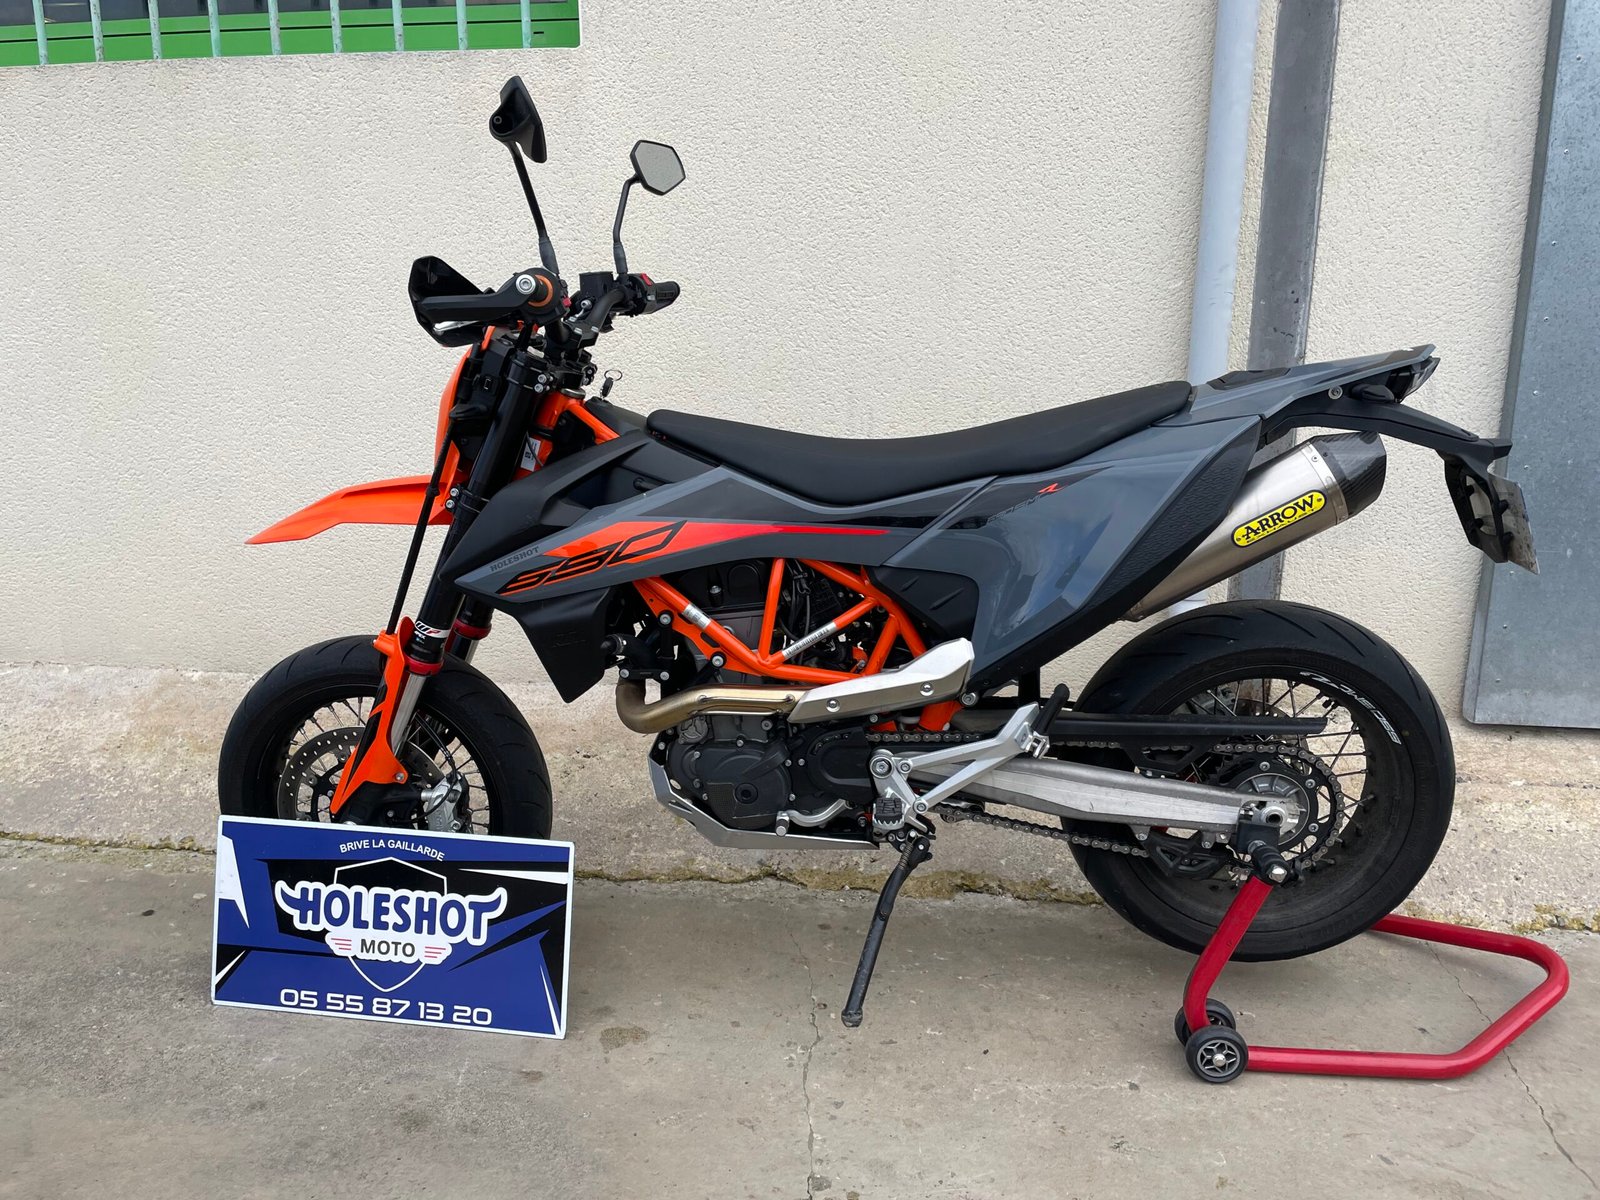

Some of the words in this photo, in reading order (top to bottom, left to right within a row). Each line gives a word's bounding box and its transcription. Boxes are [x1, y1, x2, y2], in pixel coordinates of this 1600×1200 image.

[1242, 494, 1314, 540] ARROW
[490, 546, 540, 572] HOLESHOT
[339, 839, 370, 853] BRIVE
[372, 839, 386, 848] LA
[387, 839, 445, 862] GAILLARDE
[278, 884, 504, 942] HOLESHOT
[360, 938, 416, 958] MOTO
[280, 988, 318, 1008] 05
[326, 992, 364, 1013] 55
[372, 997, 410, 1017] 87
[418, 1001, 444, 1021] 13
[452, 1005, 492, 1026] 20
